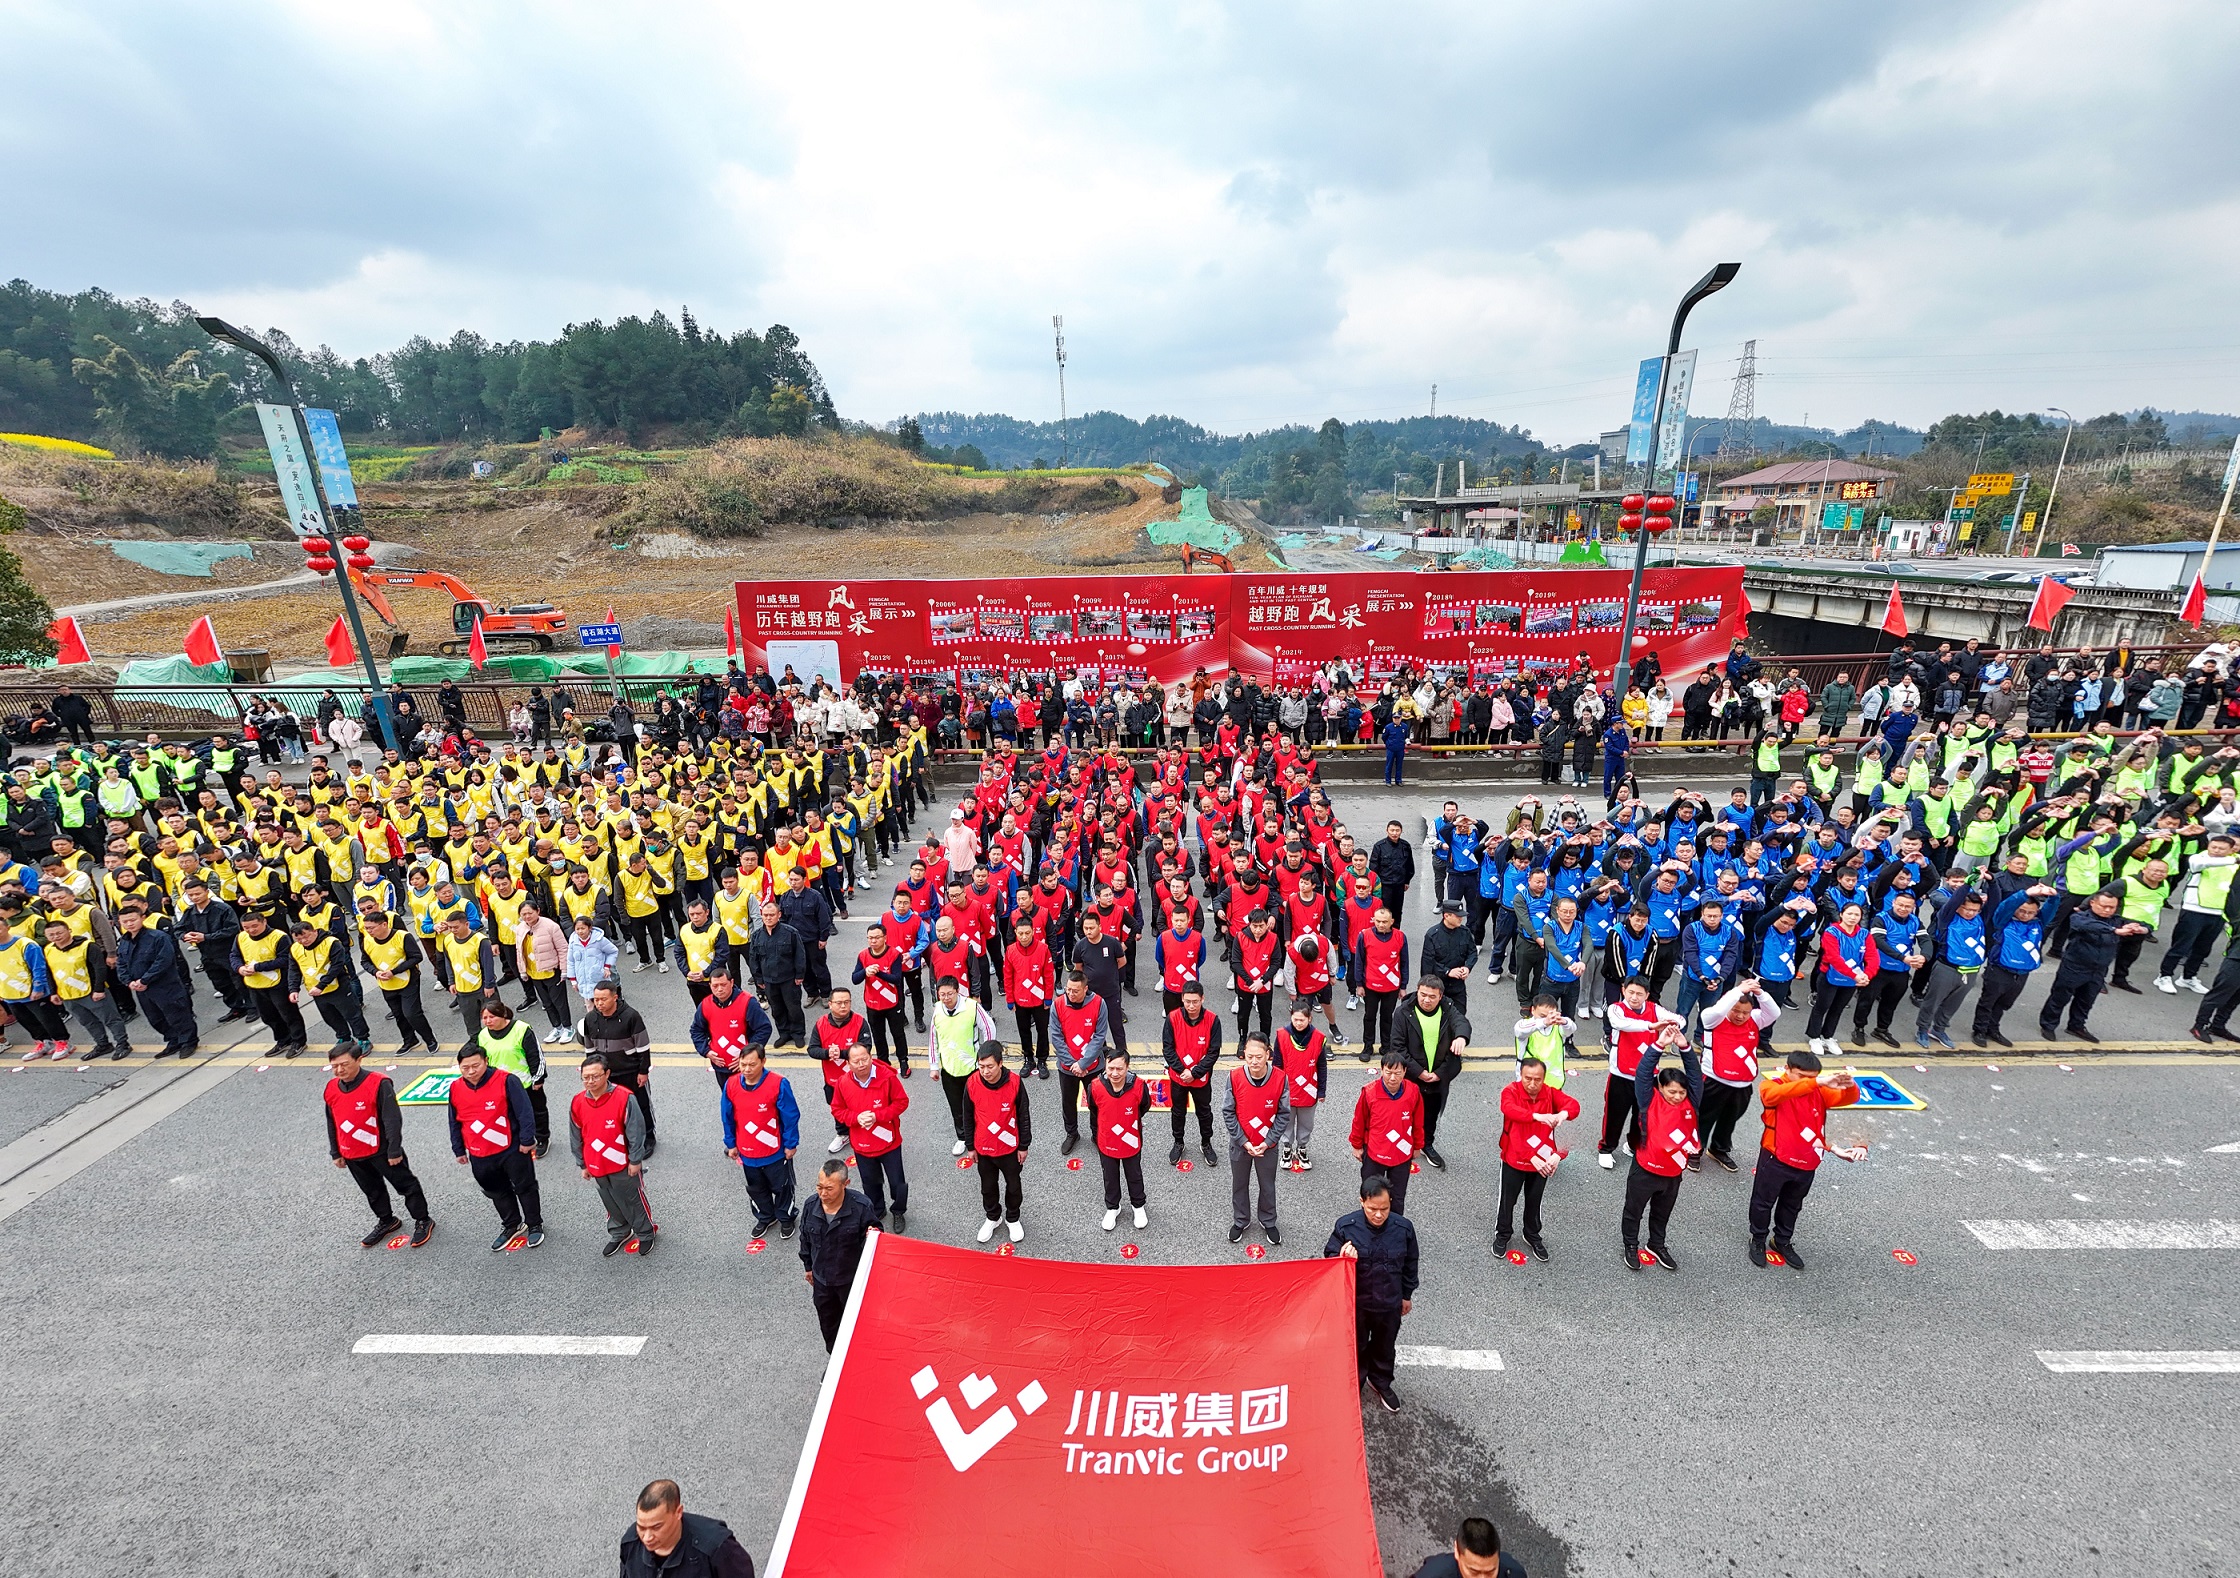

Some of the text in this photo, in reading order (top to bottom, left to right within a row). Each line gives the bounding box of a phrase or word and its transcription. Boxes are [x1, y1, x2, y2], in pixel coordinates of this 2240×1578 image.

[1843, 481, 1877, 491] 安全第一
[1842, 489, 1876, 499] 预防为主
[1247, 584, 1327, 596] 百年川威 十年规划
[1638, 589, 1657, 597] 020年
[1432, 593, 1454, 601] 2018年
[1534, 591, 1557, 599] 2019年
[756, 594, 800, 605] 川威集团
[1178, 597, 1199, 605] 2011年
[935, 600, 957, 608] 2006年
[1031, 601, 1052, 609] 2008年
[1248, 605, 1300, 624] 越野跑
[1365, 600, 1396, 613] 展示
[756, 611, 841, 628] 历年越野跑
[869, 608, 898, 620] 展示
[1281, 648, 1303, 656] 2021年
[1473, 647, 1495, 655] 2023年
[960, 654, 981, 662] 2014年
[1010, 657, 1031, 665] 2015年
[1055, 655, 1076, 663] 2016年
[1104, 653, 1126, 661] 2017年
[961, 1159, 969, 1167] 3
[1000, 1246, 1010, 1256] 3
[1512, 1253, 1520, 1261] 6
[1640, 1254, 1650, 1262] 8
[1766, 1254, 1782, 1262] 10
[1895, 1252, 1914, 1261] 12
[1064, 1383, 1289, 1439] 川威集团
[1196, 1443, 1288, 1475] Group
